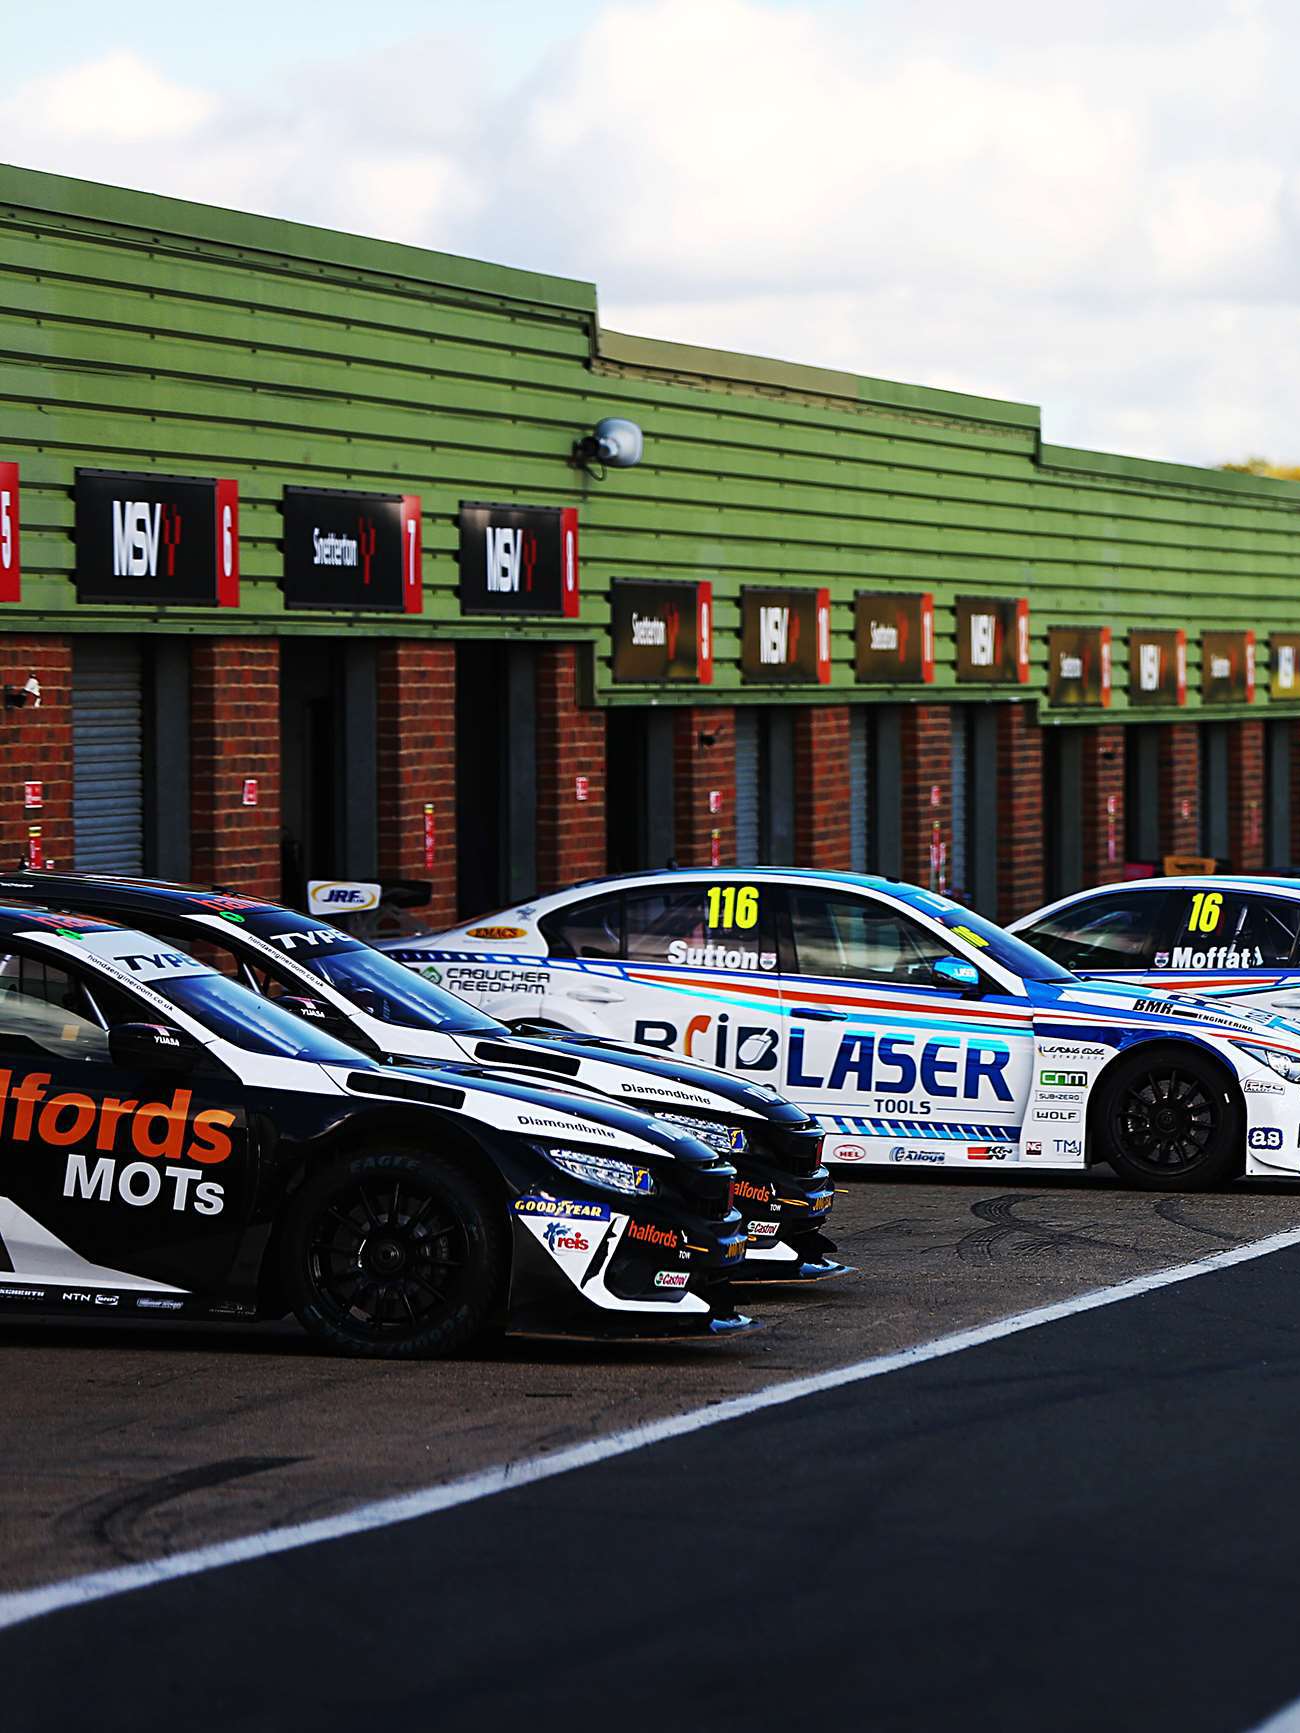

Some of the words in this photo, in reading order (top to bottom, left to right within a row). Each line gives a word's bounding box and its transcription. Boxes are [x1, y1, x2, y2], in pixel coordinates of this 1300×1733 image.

[113, 501, 162, 576] MSV
[223, 505, 233, 577] 6
[407, 519, 417, 585] 7
[486, 527, 523, 592] MSV
[323, 890, 361, 903] JRF
[708, 887, 760, 929] 116
[1188, 893, 1223, 932] 16
[668, 940, 758, 970] Sutton
[1171, 946, 1251, 968] Moffat
[87, 954, 174, 1012] hondaengineroom.co.uk
[446, 968, 550, 983] CROUCHER
[450, 980, 546, 995] NEEDHAM
[154, 1036, 180, 1047] YUASA
[786, 1027, 1015, 1103] LASER
[874, 1099, 931, 1116] TOOLS
[1036, 1111, 1078, 1120] WOLF
[839, 1150, 860, 1159] HEL
[63, 1153, 225, 1216] MOTs
[734, 1181, 770, 1203] alfords
[514, 1200, 602, 1217] GOODYEAR
[770, 1204, 782, 1212] TOW
[557, 1232, 590, 1250] reis
[628, 1220, 678, 1249] halfords
[63, 1292, 92, 1302] NTN
